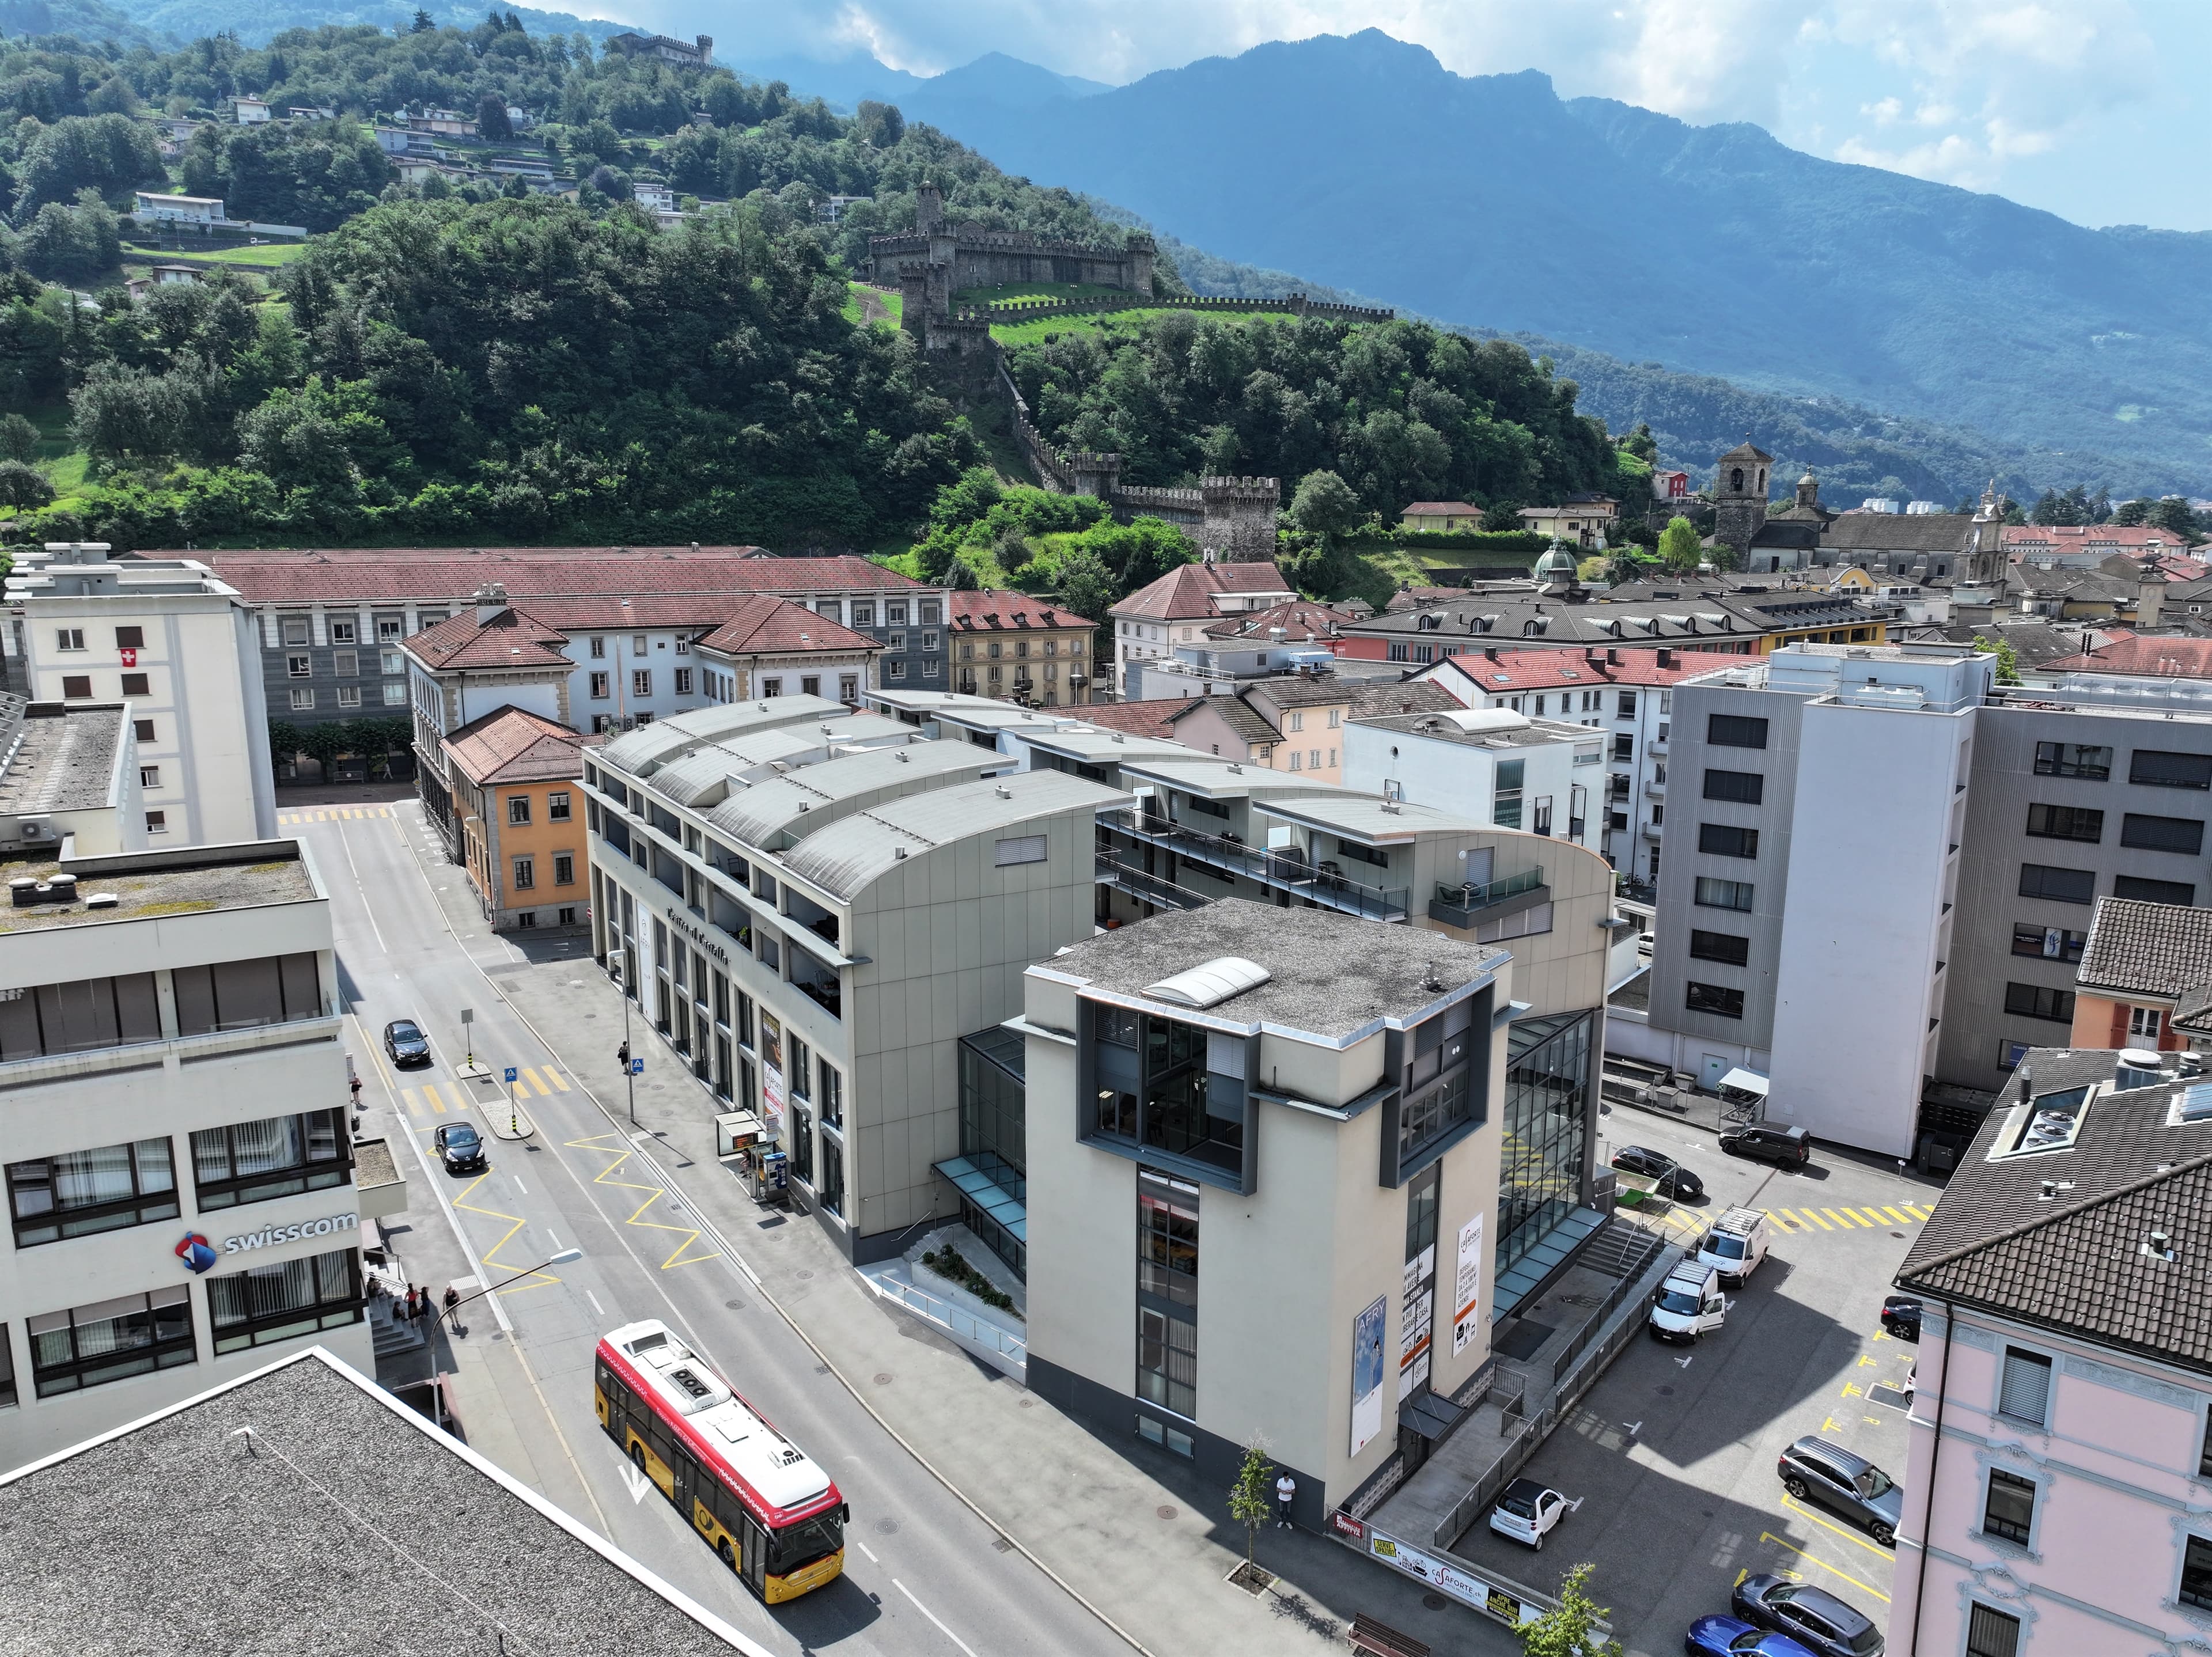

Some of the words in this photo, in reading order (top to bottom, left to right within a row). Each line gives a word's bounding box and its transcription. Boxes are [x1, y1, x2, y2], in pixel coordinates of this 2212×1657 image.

[668, 907, 689, 932] Centro
[699, 932, 729, 965] Castello
[224, 1212, 358, 1255] swisscom
[1460, 1227, 1480, 1253] CASAFORTE
[1459, 1260, 1472, 1276] DEPOSITI
[1459, 1264, 1476, 1284] TEMPORANEI
[1410, 1284, 1424, 1303] STANZA
[1464, 1281, 1475, 1295] PRIVATI
[1359, 1300, 1385, 1333] AFRY
[1336, 1522, 1360, 1537] AFFITTA
[1376, 1546, 1395, 1556] SPAZIO?
[1377, 1541, 1392, 1549] SERVE
[1431, 1568, 1481, 1598] CASAFORTE.ch
[1489, 1596, 1506, 1609] ANCHE
[1508, 1605, 1518, 1614] QUI!
[1498, 1594, 1511, 1605] APRE
